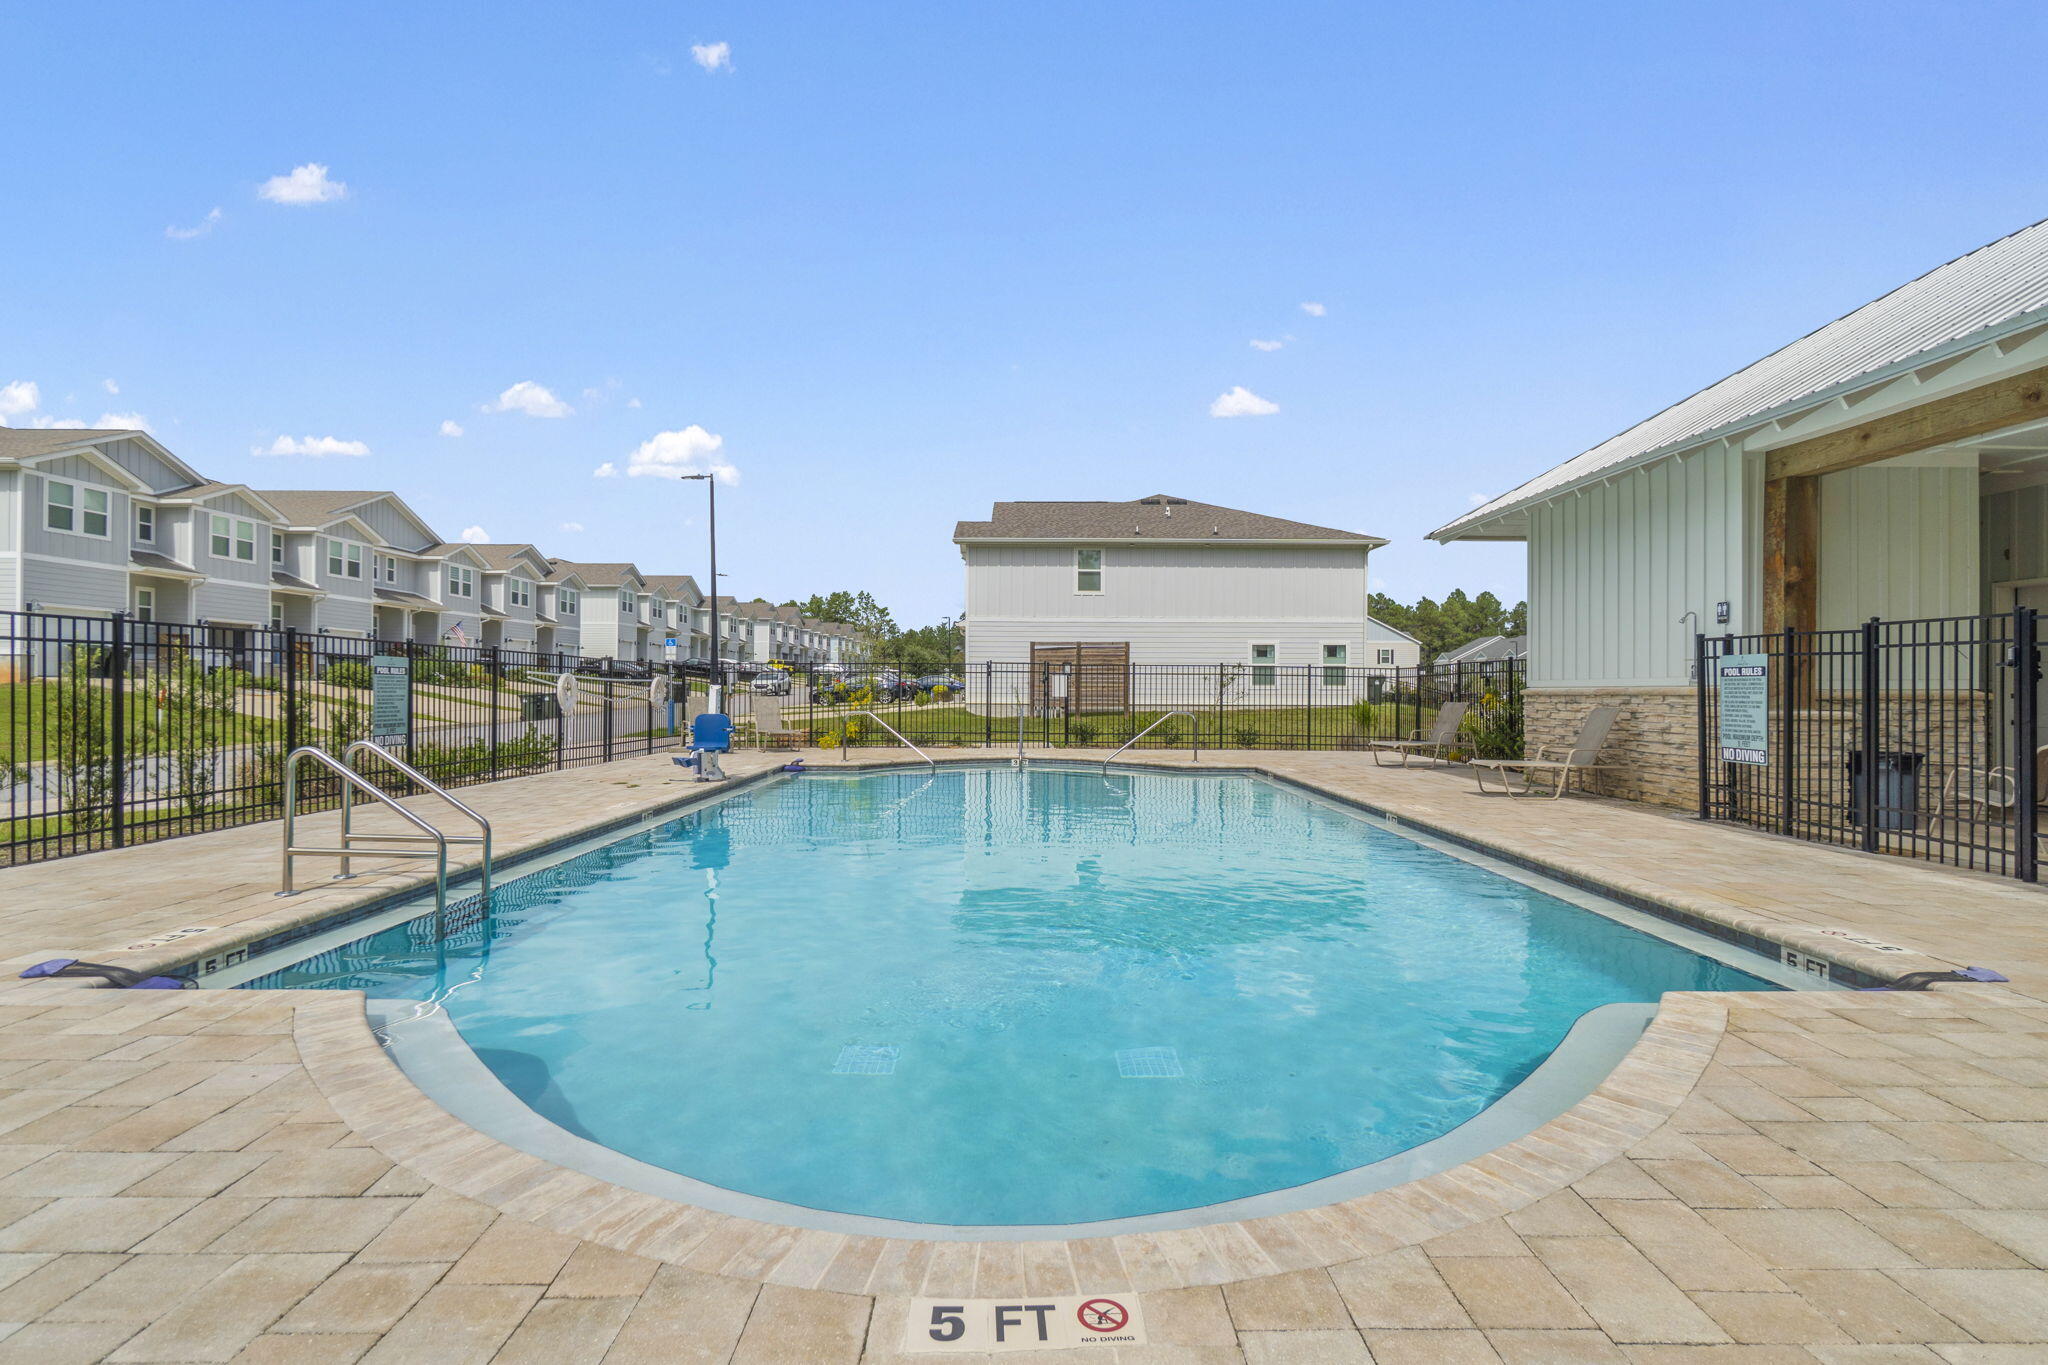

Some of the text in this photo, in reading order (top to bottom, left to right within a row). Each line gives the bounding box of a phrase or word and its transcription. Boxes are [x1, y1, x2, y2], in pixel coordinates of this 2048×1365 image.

[1723, 667, 1762, 676] POOL RULES
[375, 734, 406, 746] NO DIVING
[1723, 748, 1765, 763] NO DIVING
[205, 949, 246, 974] 5 FT
[1786, 951, 1827, 976] 5 FT
[929, 1304, 1056, 1342] 5 FT
